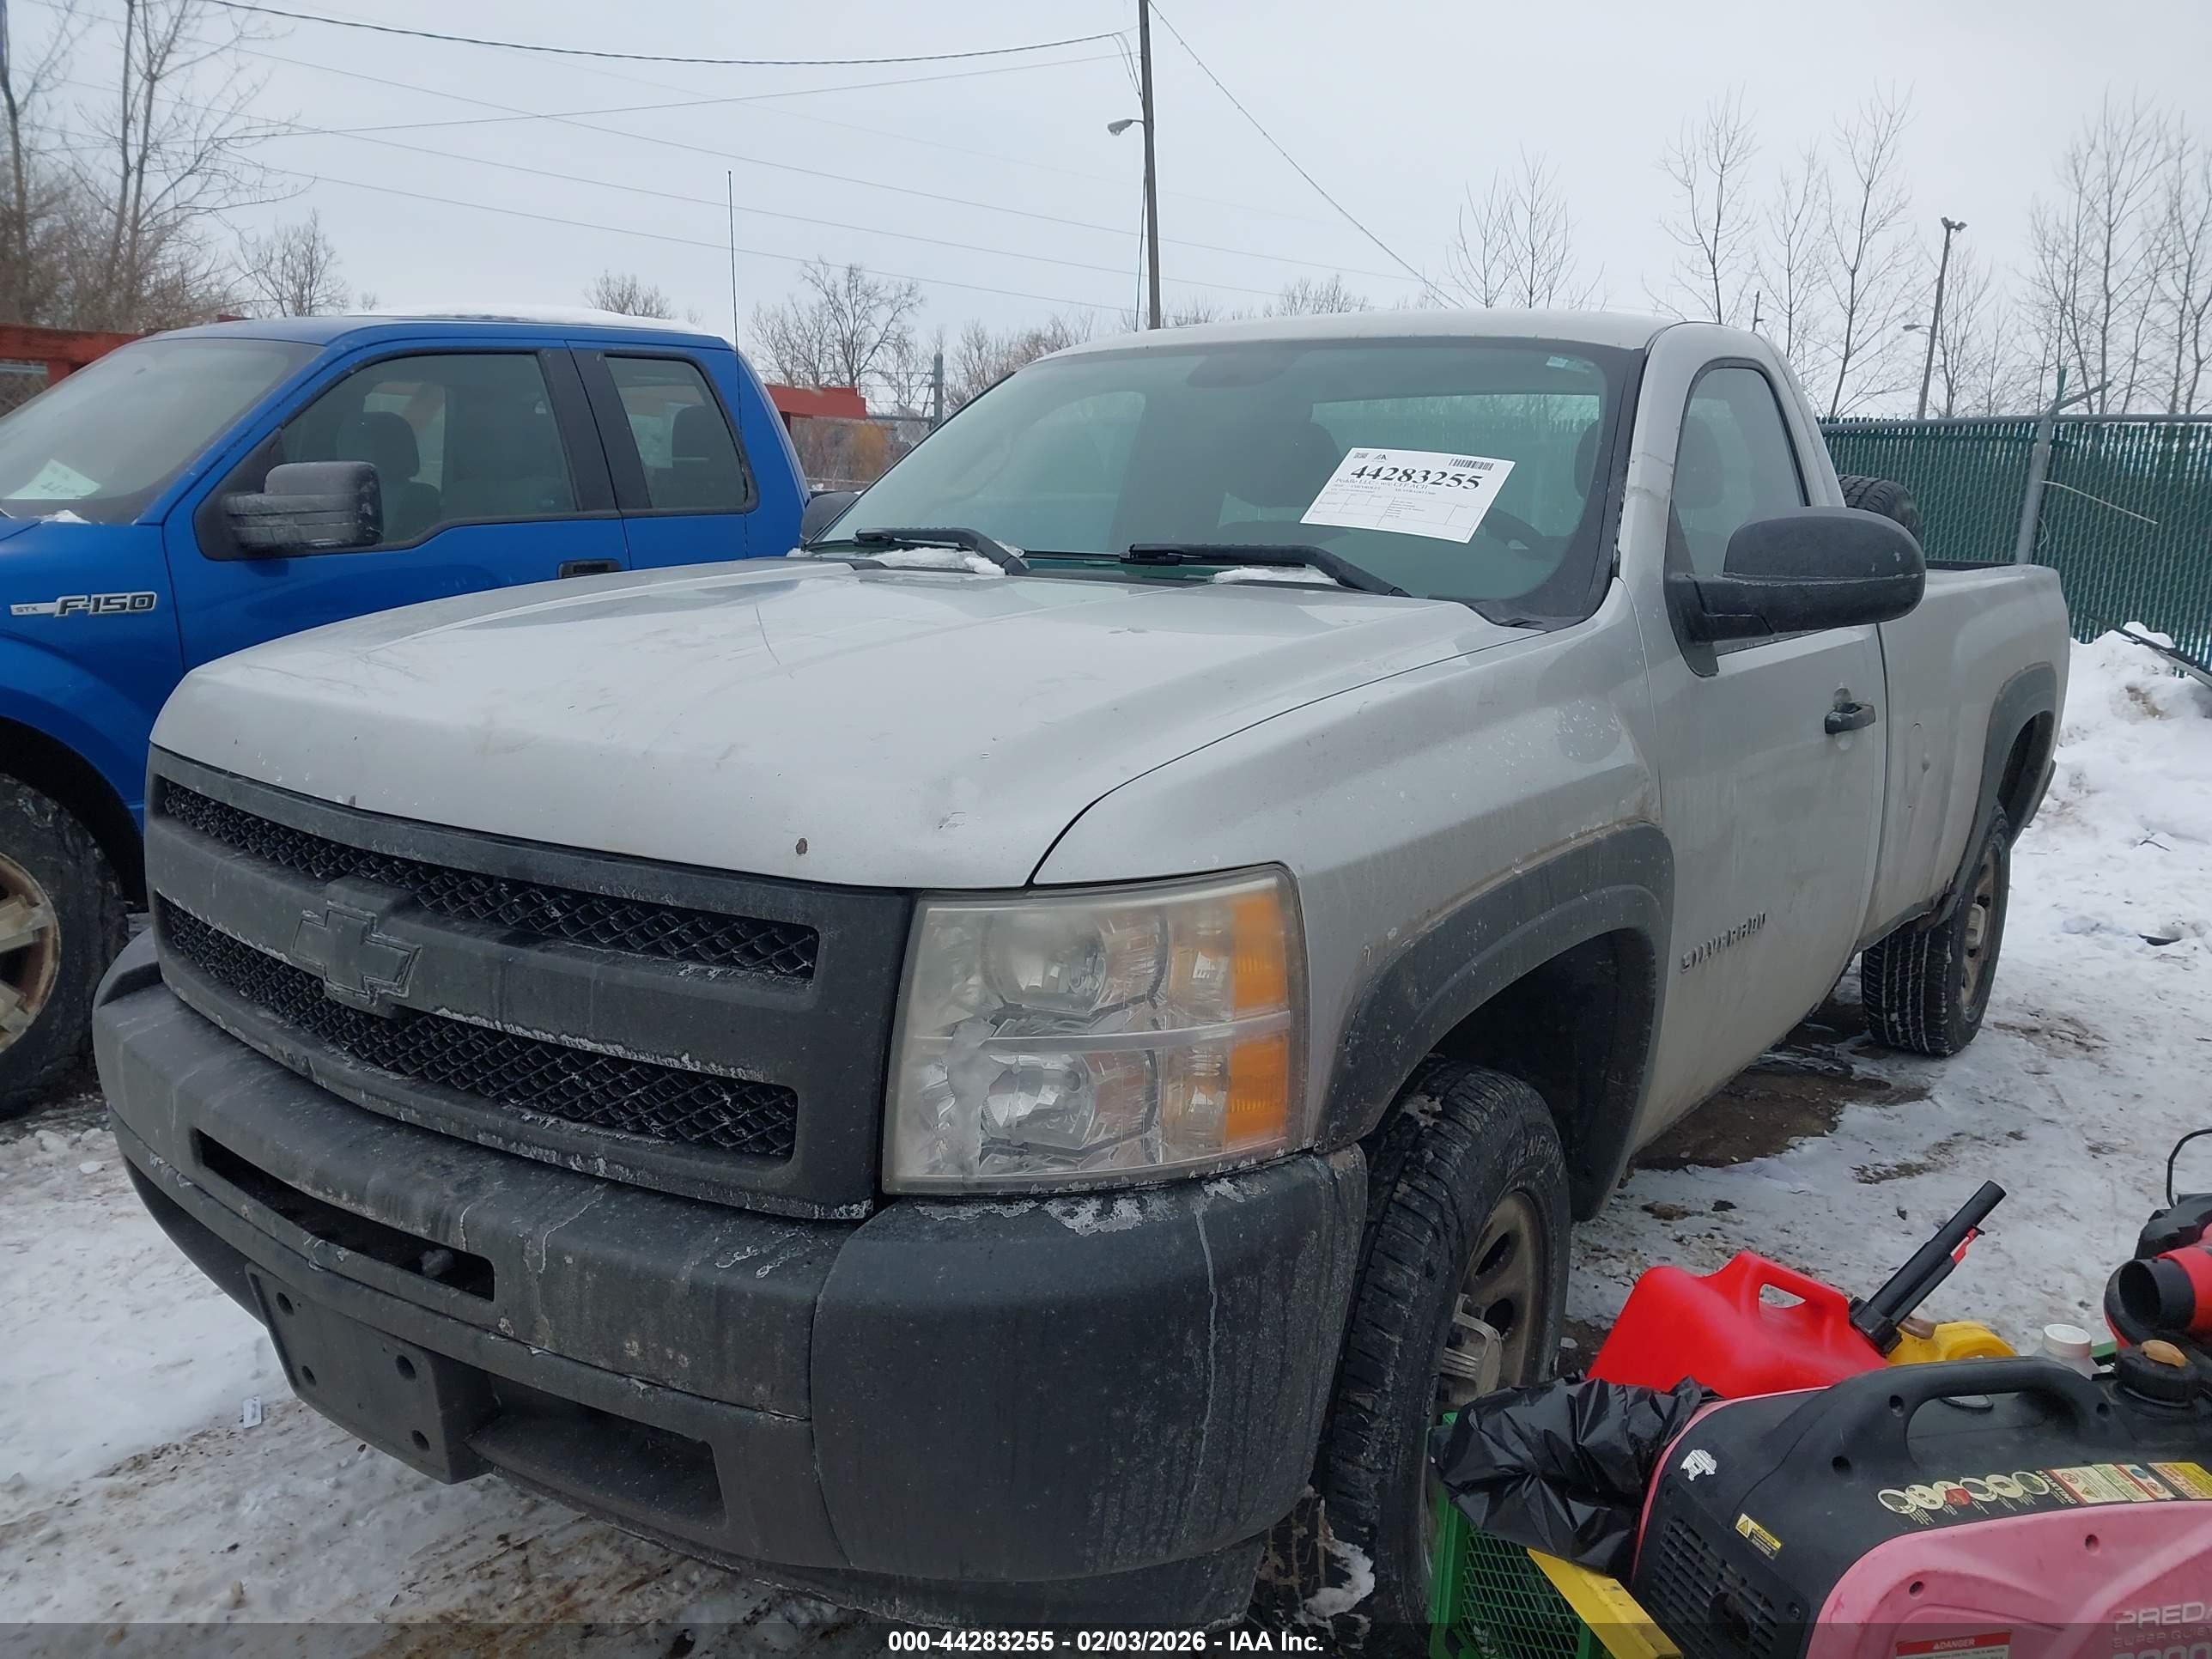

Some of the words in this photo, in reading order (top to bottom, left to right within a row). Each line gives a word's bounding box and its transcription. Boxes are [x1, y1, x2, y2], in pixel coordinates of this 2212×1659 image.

[1351, 465, 1483, 490] 44283255
[54, 591, 156, 617] F-150
[1939, 1638, 1976, 1650] DANGER
[2112, 1632, 2166, 1649] SUPER
